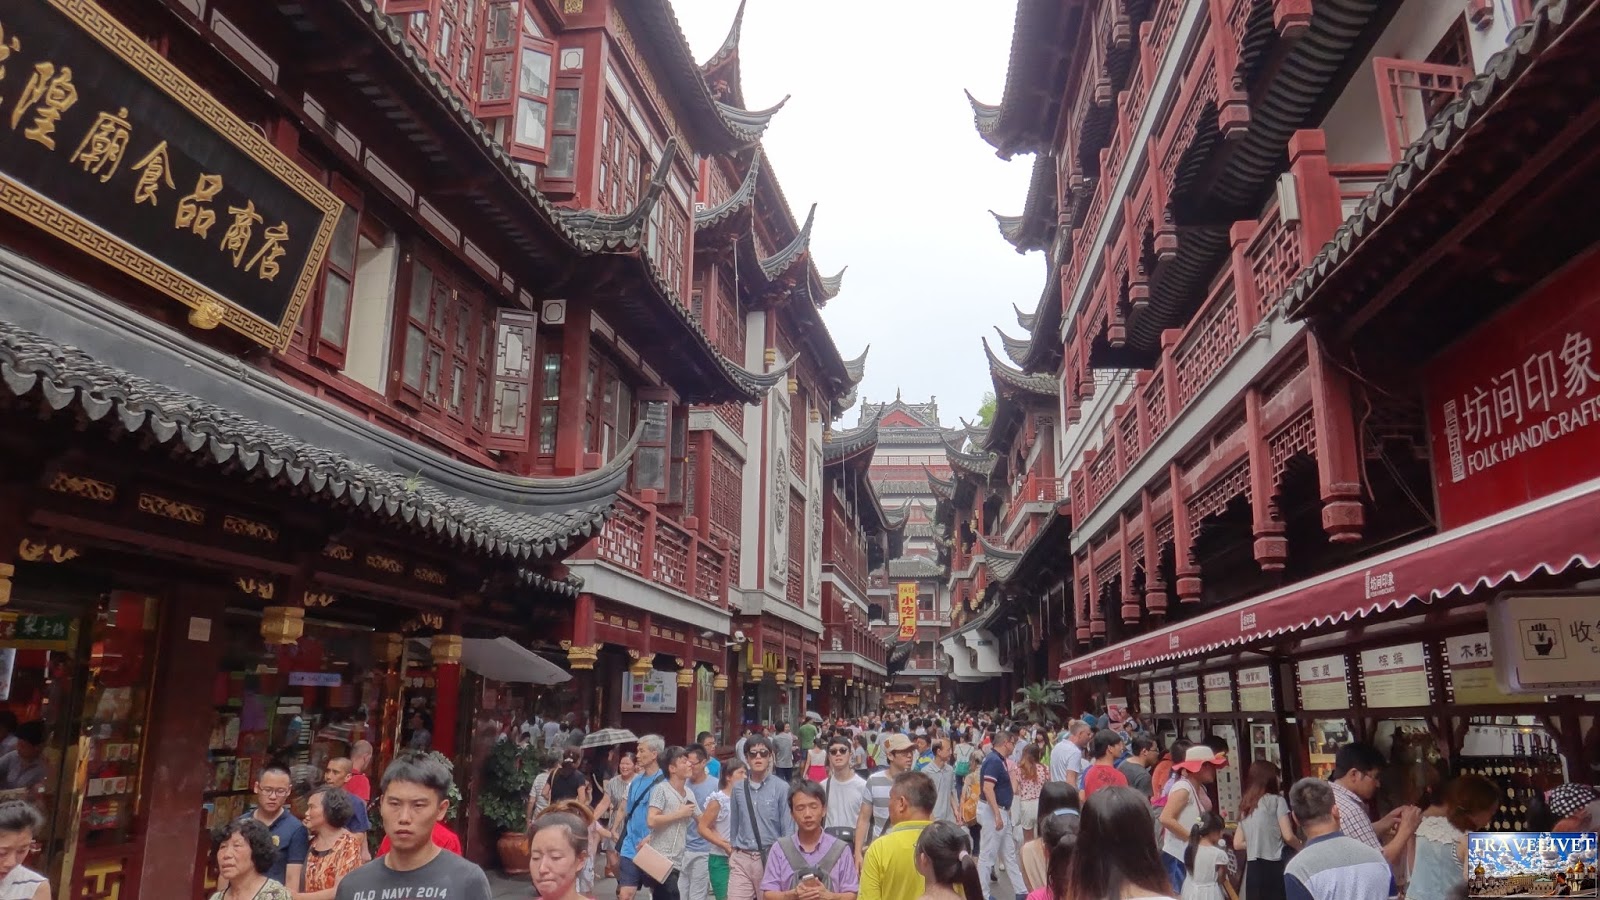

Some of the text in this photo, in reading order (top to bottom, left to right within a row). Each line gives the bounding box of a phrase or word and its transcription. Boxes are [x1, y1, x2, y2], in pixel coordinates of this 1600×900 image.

[1462, 332, 1600, 443] 坊间印象
[1467, 442, 1500, 476] FOLK
[1501, 394, 1600, 461] HANDICRAFTS
[901, 596, 914, 635] 小吃广场
[1569, 620, 1600, 643] 收
[353, 887, 448, 900] OLD NAVY 2014
